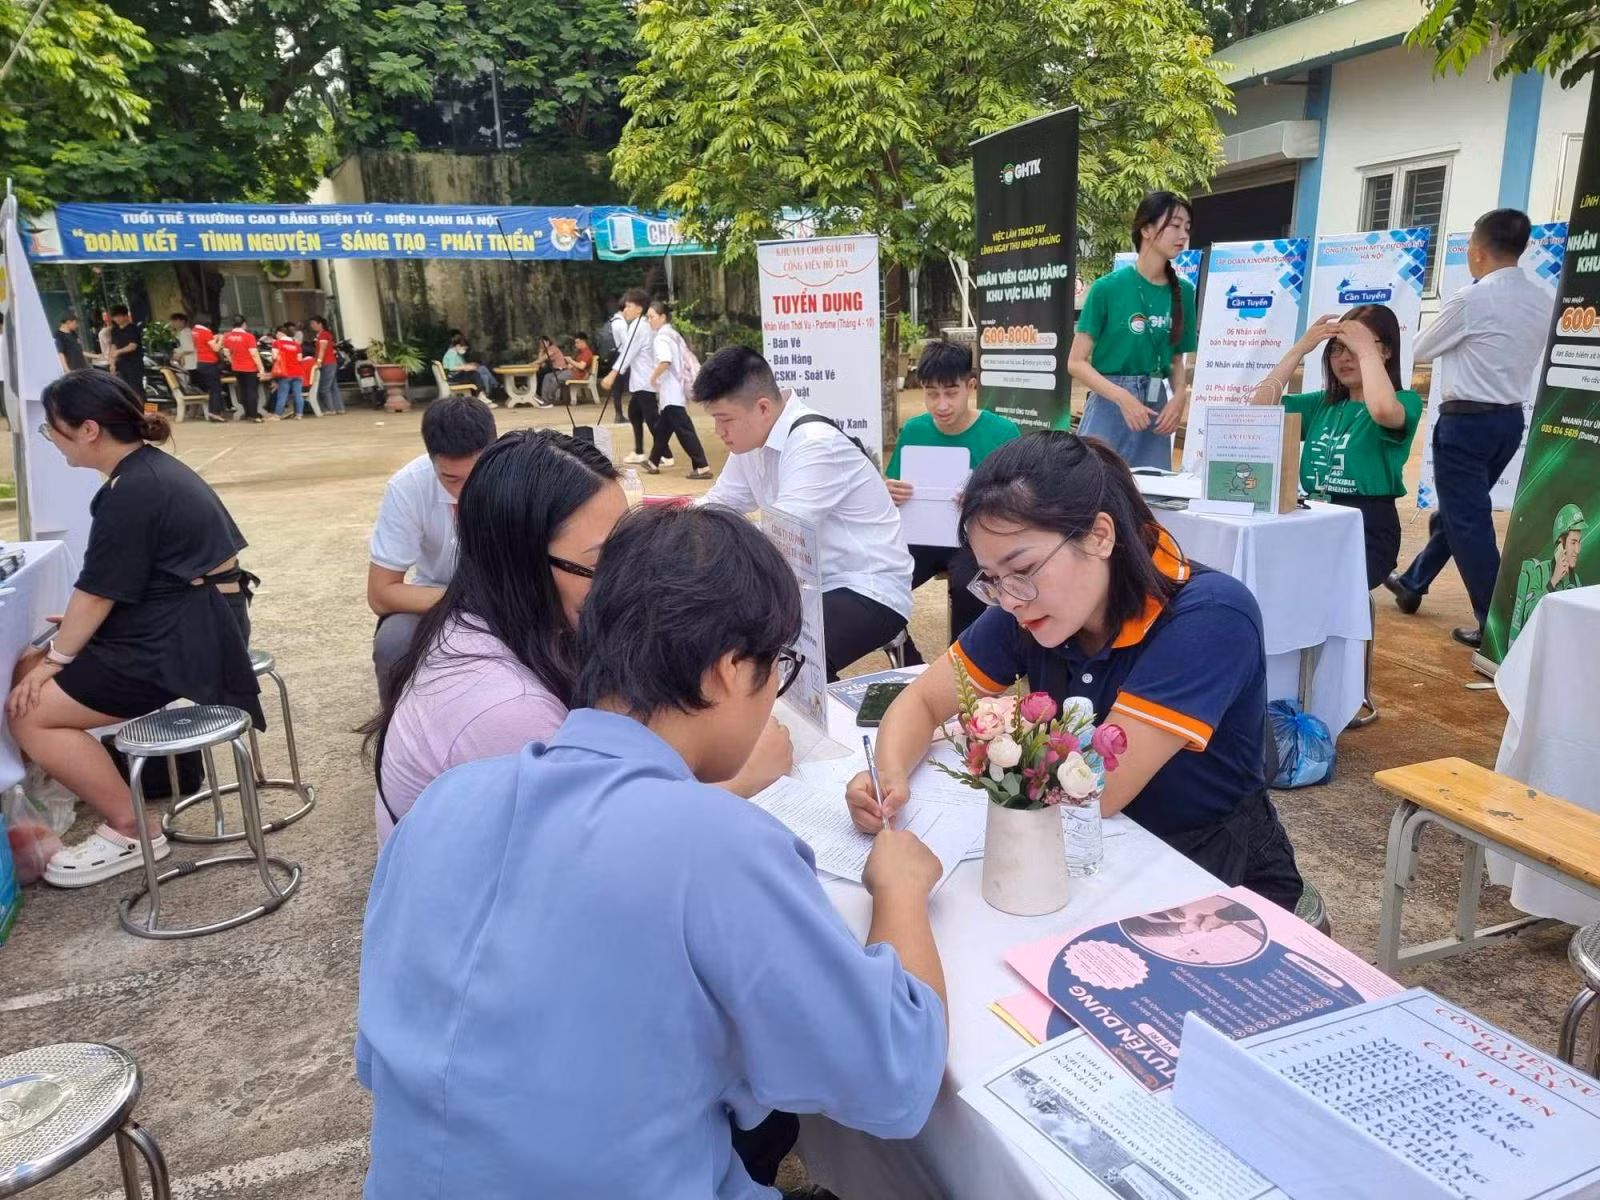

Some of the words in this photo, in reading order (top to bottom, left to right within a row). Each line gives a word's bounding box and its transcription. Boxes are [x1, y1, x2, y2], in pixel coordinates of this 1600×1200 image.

[1015, 158, 1041, 179] GHTK
[157, 211, 185, 224] TRẺ
[188, 211, 245, 224] TRƯỜNG
[248, 213, 276, 224] CAO
[280, 211, 318, 225] ĐẲNG
[320, 213, 353, 227] ĐIỆN
[384, 213, 418, 227] ĐIỆN
[419, 214, 453, 227] LẠNH
[456, 213, 474, 225] HÀ
[142, 228, 178, 252] KẾT
[199, 229, 243, 252] TÌNH
[247, 230, 321, 255] NGUYỆN
[341, 229, 389, 251] SÁNG
[393, 232, 426, 255] TẠO
[440, 230, 484, 251] PHÁT
[1566, 230, 1598, 252] NHÂN
[977, 271, 998, 287] NHÂN
[998, 269, 1017, 285] VIÊN
[1018, 268, 1039, 282] GIAO
[1040, 263, 1068, 281] HÀNG
[772, 287, 817, 314] TUYỂN
[822, 291, 863, 316] DỤNG
[986, 289, 1004, 303] KHU
[1004, 286, 1021, 304] VỰC
[1022, 283, 1035, 300] HÀ
[1036, 281, 1052, 302] NỘI
[772, 337, 788, 349] Bán
[773, 354, 789, 365] Bán
[791, 353, 812, 366] Hàng
[774, 370, 797, 381] CSKH
[804, 369, 823, 381] Soát
[847, 418, 868, 429] Xanh
[1066, 983, 1123, 1028] DỤNG
[1113, 1026, 1177, 1078] TUYỂN
